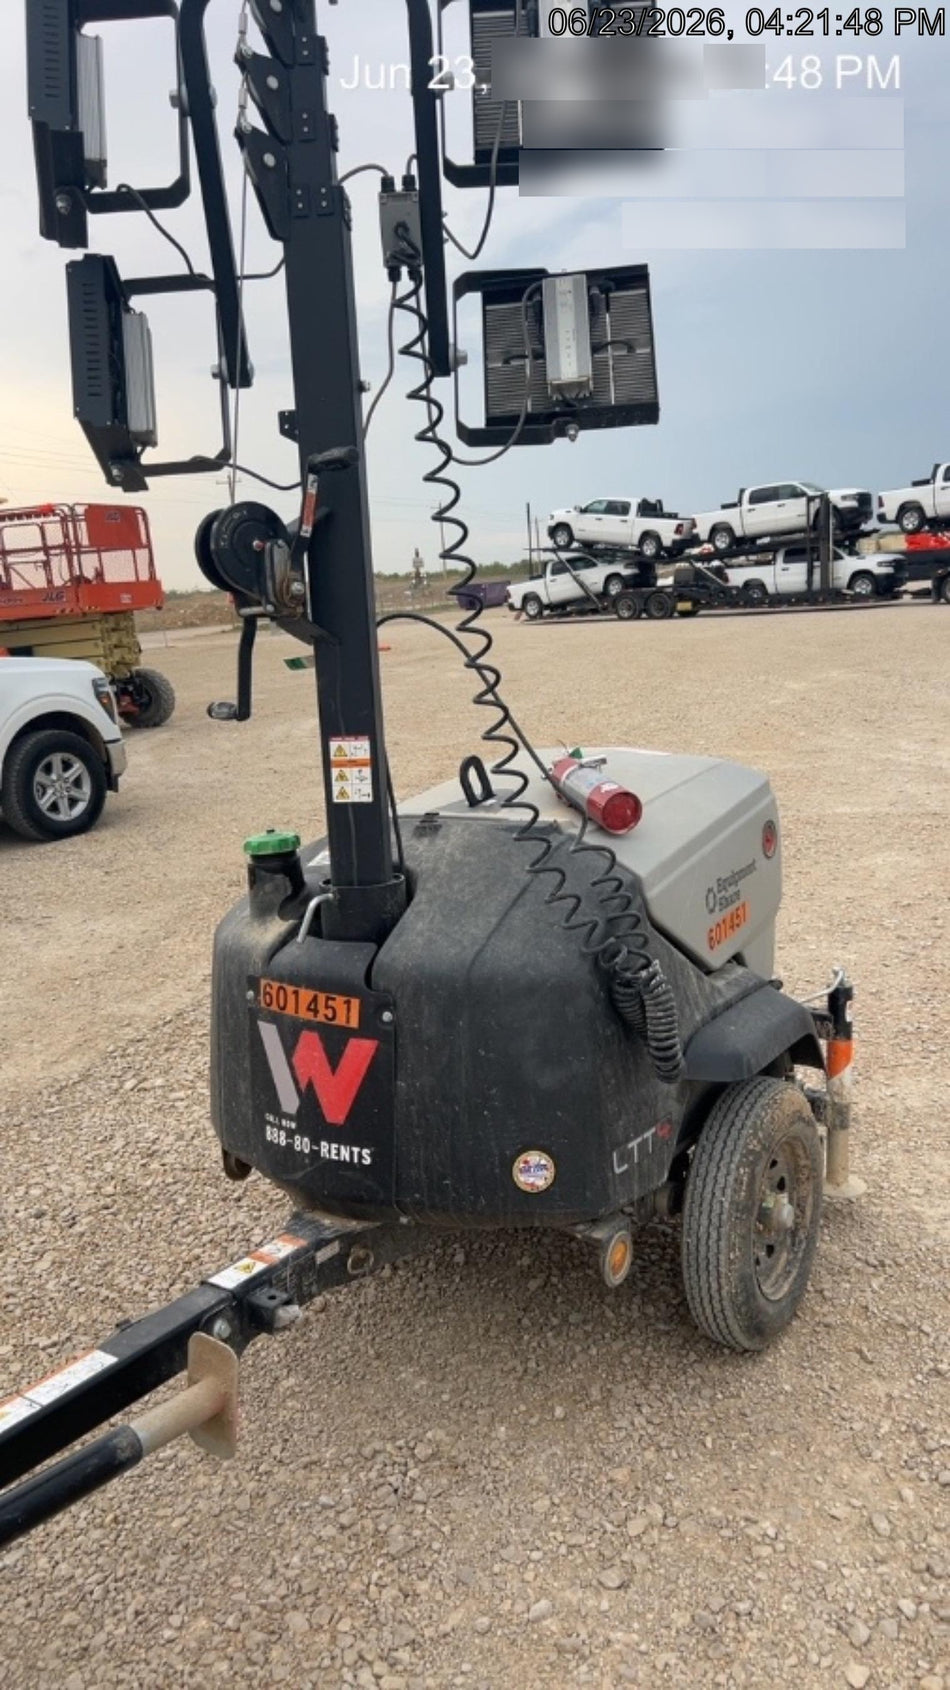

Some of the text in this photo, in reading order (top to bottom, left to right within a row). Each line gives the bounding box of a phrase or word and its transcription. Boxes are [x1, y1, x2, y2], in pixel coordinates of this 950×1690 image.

[708, 901, 747, 951] 601451
[262, 982, 354, 1024] 601451
[265, 1124, 372, 1166] 888-80-RENTS
